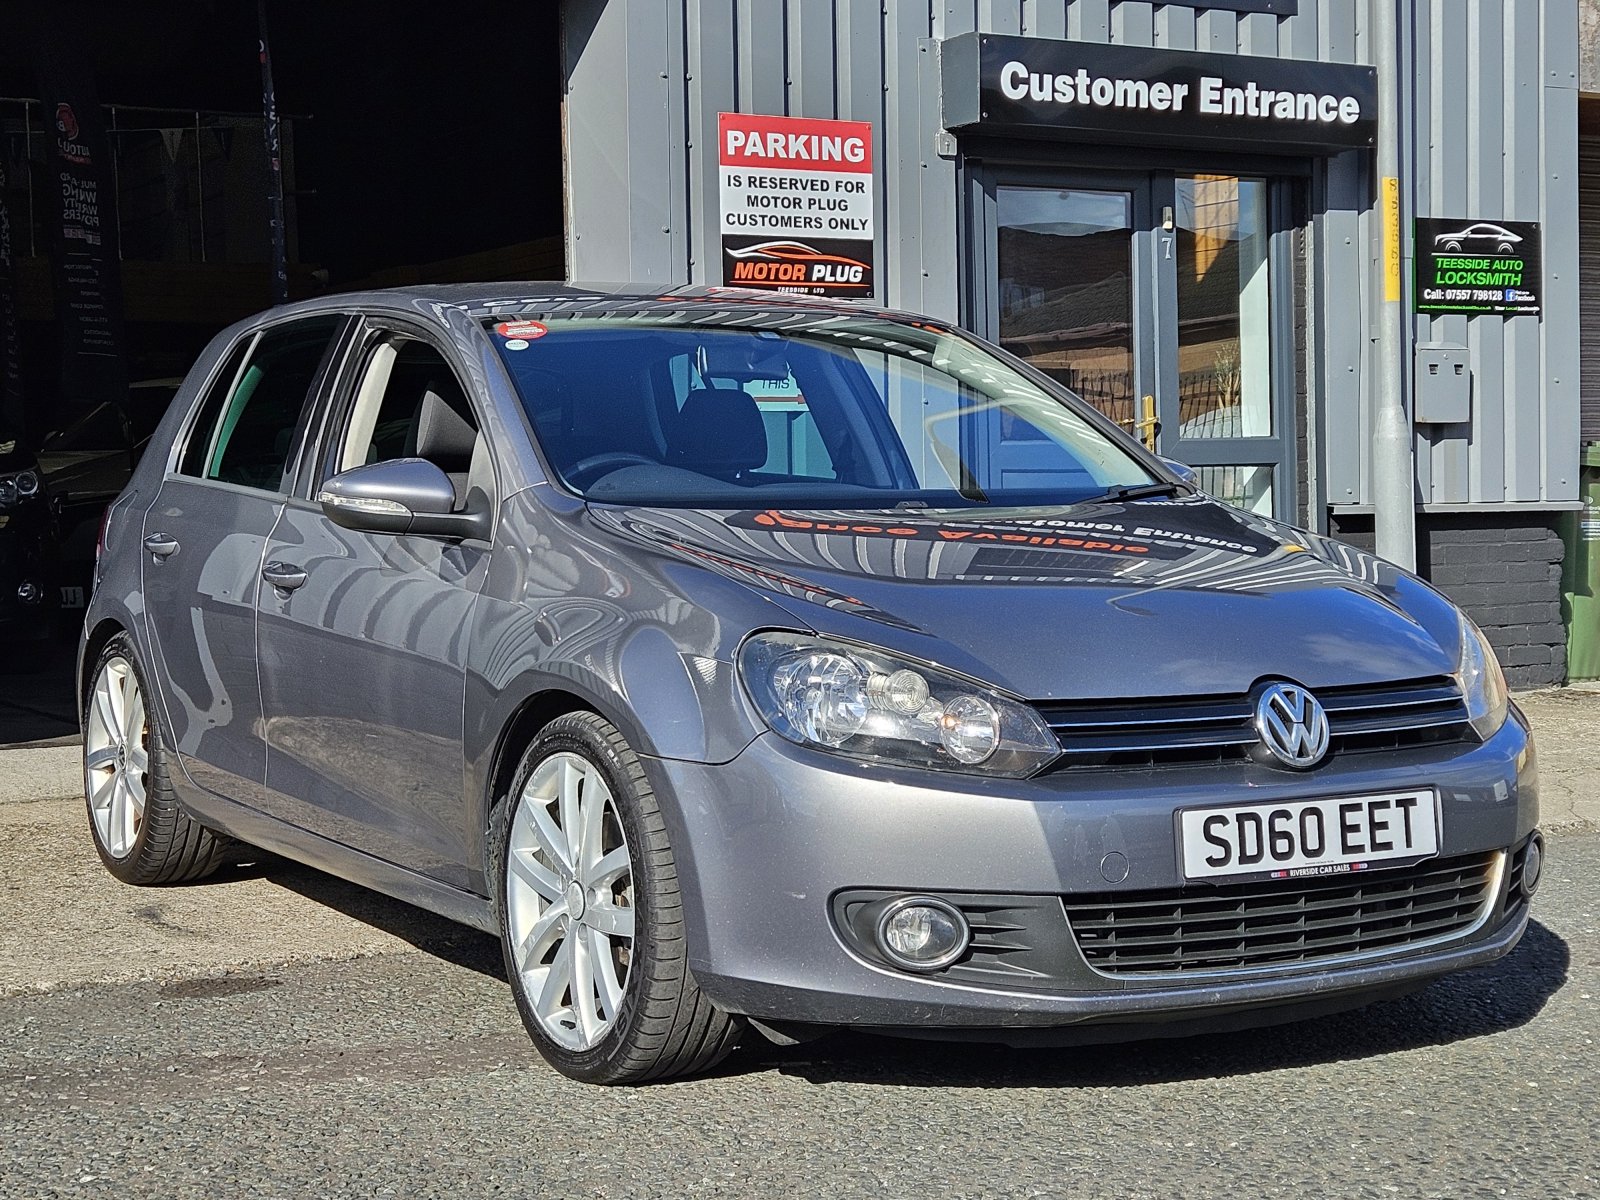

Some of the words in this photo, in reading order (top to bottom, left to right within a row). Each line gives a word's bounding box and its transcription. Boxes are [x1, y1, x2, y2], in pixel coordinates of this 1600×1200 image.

[1000, 60, 1189, 111] Customer
[1200, 76, 1361, 125] Entrance
[726, 130, 865, 163] PARKING
[727, 174, 742, 188] IS
[748, 175, 830, 192] RESERVED
[835, 180, 866, 194] FOR
[746, 194, 803, 210] MOTOR
[807, 198, 849, 211] PLUG
[725, 213, 823, 229] CUSTOMERS
[828, 217, 869, 231] ONLY
[1161, 237, 1173, 260] 7
[734, 262, 806, 281] MOTOR
[812, 265, 863, 283] PLUG
[1436, 258, 1490, 270] TEESSIDE
[1492, 259, 1524, 271] AUTO
[1436, 272, 1522, 286] LOCKSMITH
[1424, 288, 1445, 300] Call:
[1446, 289, 1471, 300] 07557
[1473, 289, 1503, 301] 798128
[761, 379, 790, 389] THIS
[1203, 806, 1326, 868] SD60
[1339, 797, 1418, 856] EET
[1289, 866, 1319, 877] RIVERSIDE
[1319, 865, 1333, 874] CAR
[1333, 863, 1351, 873] SALES
